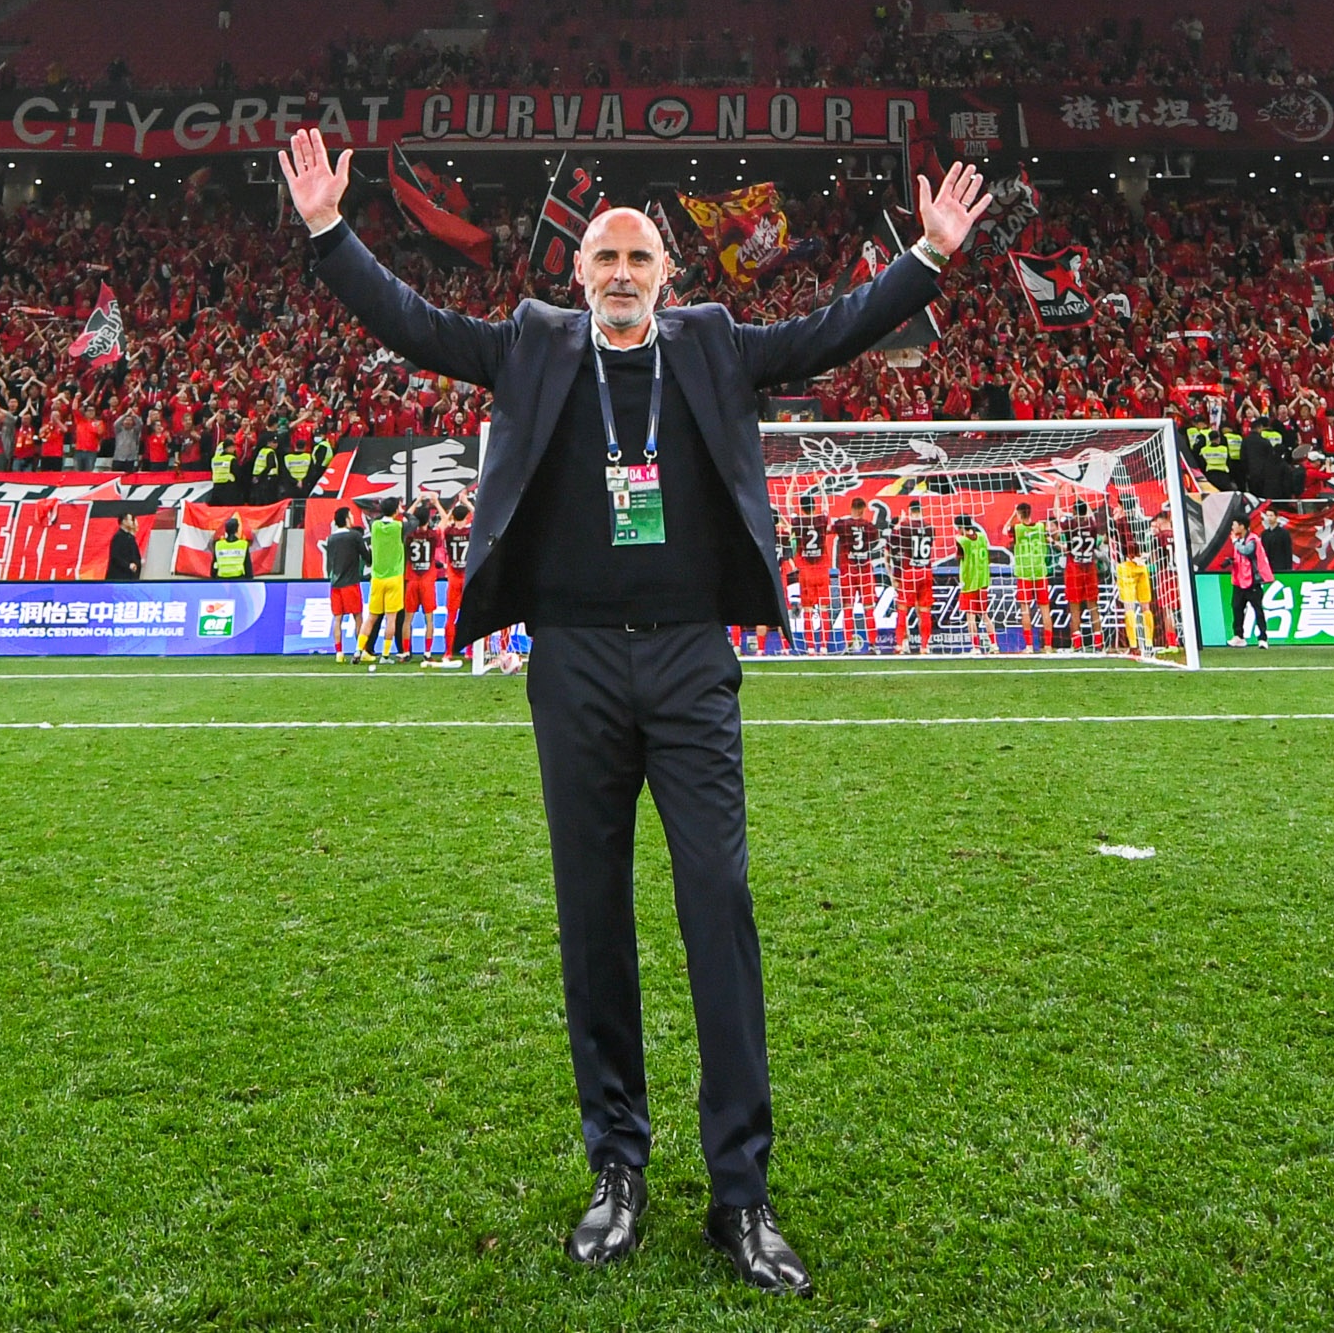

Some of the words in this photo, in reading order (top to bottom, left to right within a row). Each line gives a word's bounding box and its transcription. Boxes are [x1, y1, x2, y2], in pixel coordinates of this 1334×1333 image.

[173, 95, 389, 150] GREAT
[422, 93, 630, 142] CURVA
[716, 93, 917, 144] NORD
[950, 112, 999, 138] 根基
[805, 530, 818, 549] 2
[852, 531, 864, 550] 3
[911, 536, 931, 558] 16
[1071, 537, 1095, 556] 22
[410, 541, 430, 562] 31
[450, 541, 469, 562] 17
[95, 627, 112, 638] CFA
[114, 627, 144, 638] SUPER
[146, 627, 185, 638] LEAGUE
